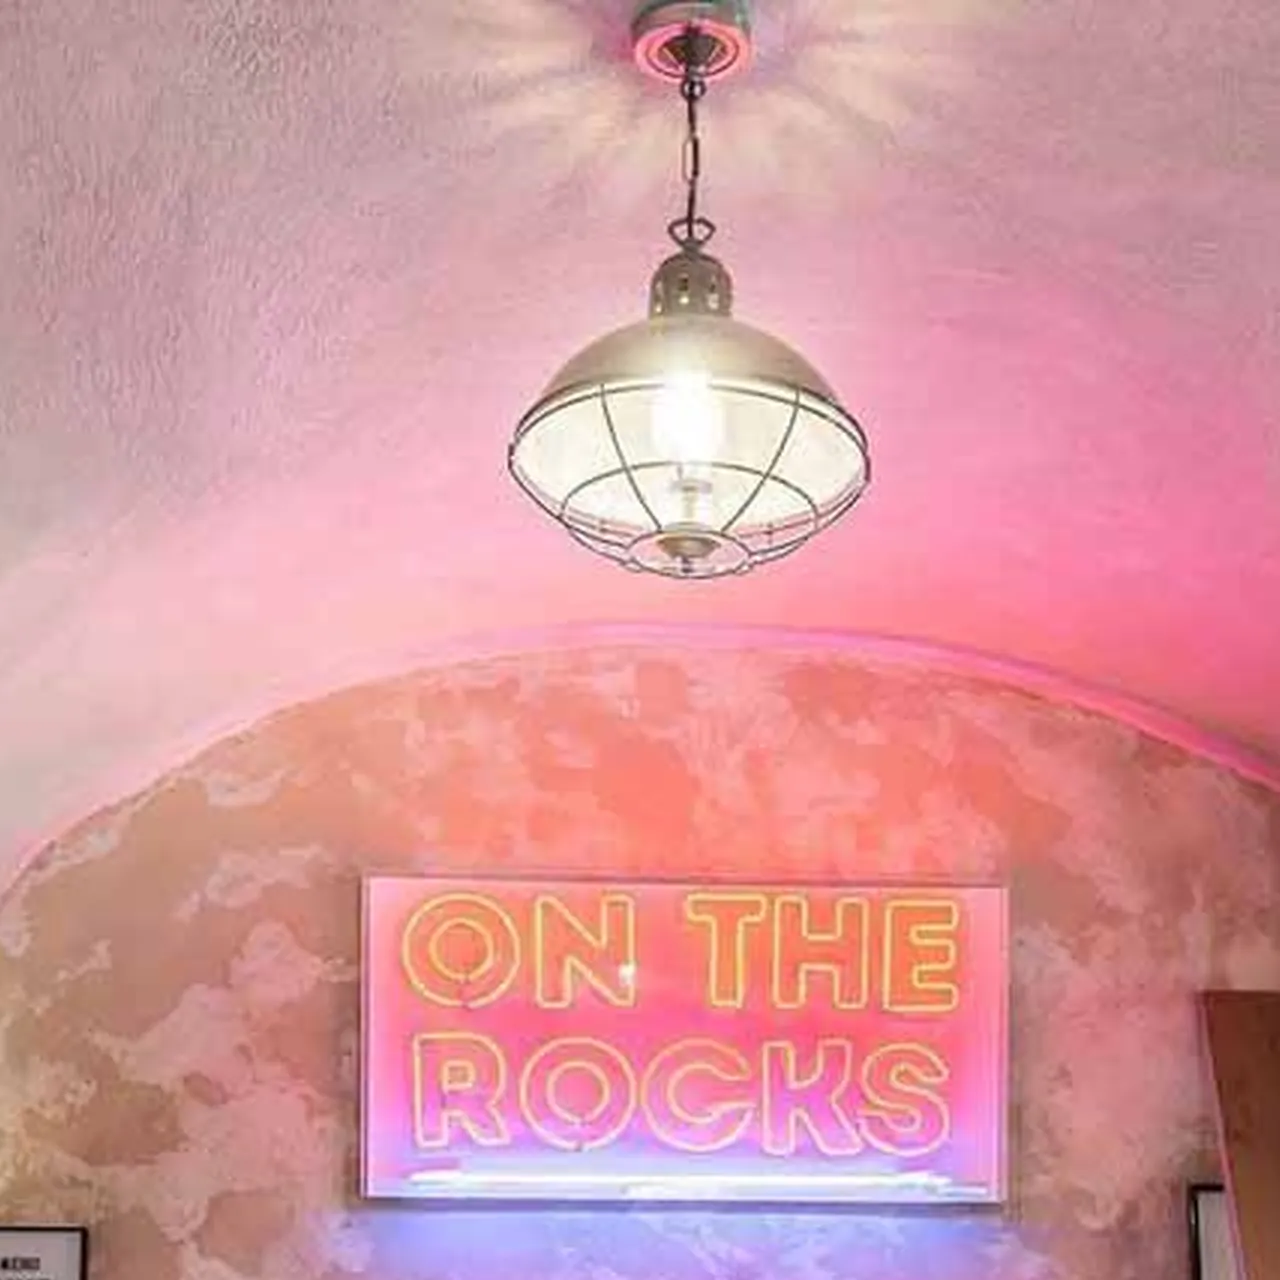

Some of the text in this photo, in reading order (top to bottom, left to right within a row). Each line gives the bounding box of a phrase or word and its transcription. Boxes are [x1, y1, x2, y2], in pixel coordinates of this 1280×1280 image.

[401, 892, 961, 1012] ON THE
[412, 1032, 952, 1157] ROCKS
